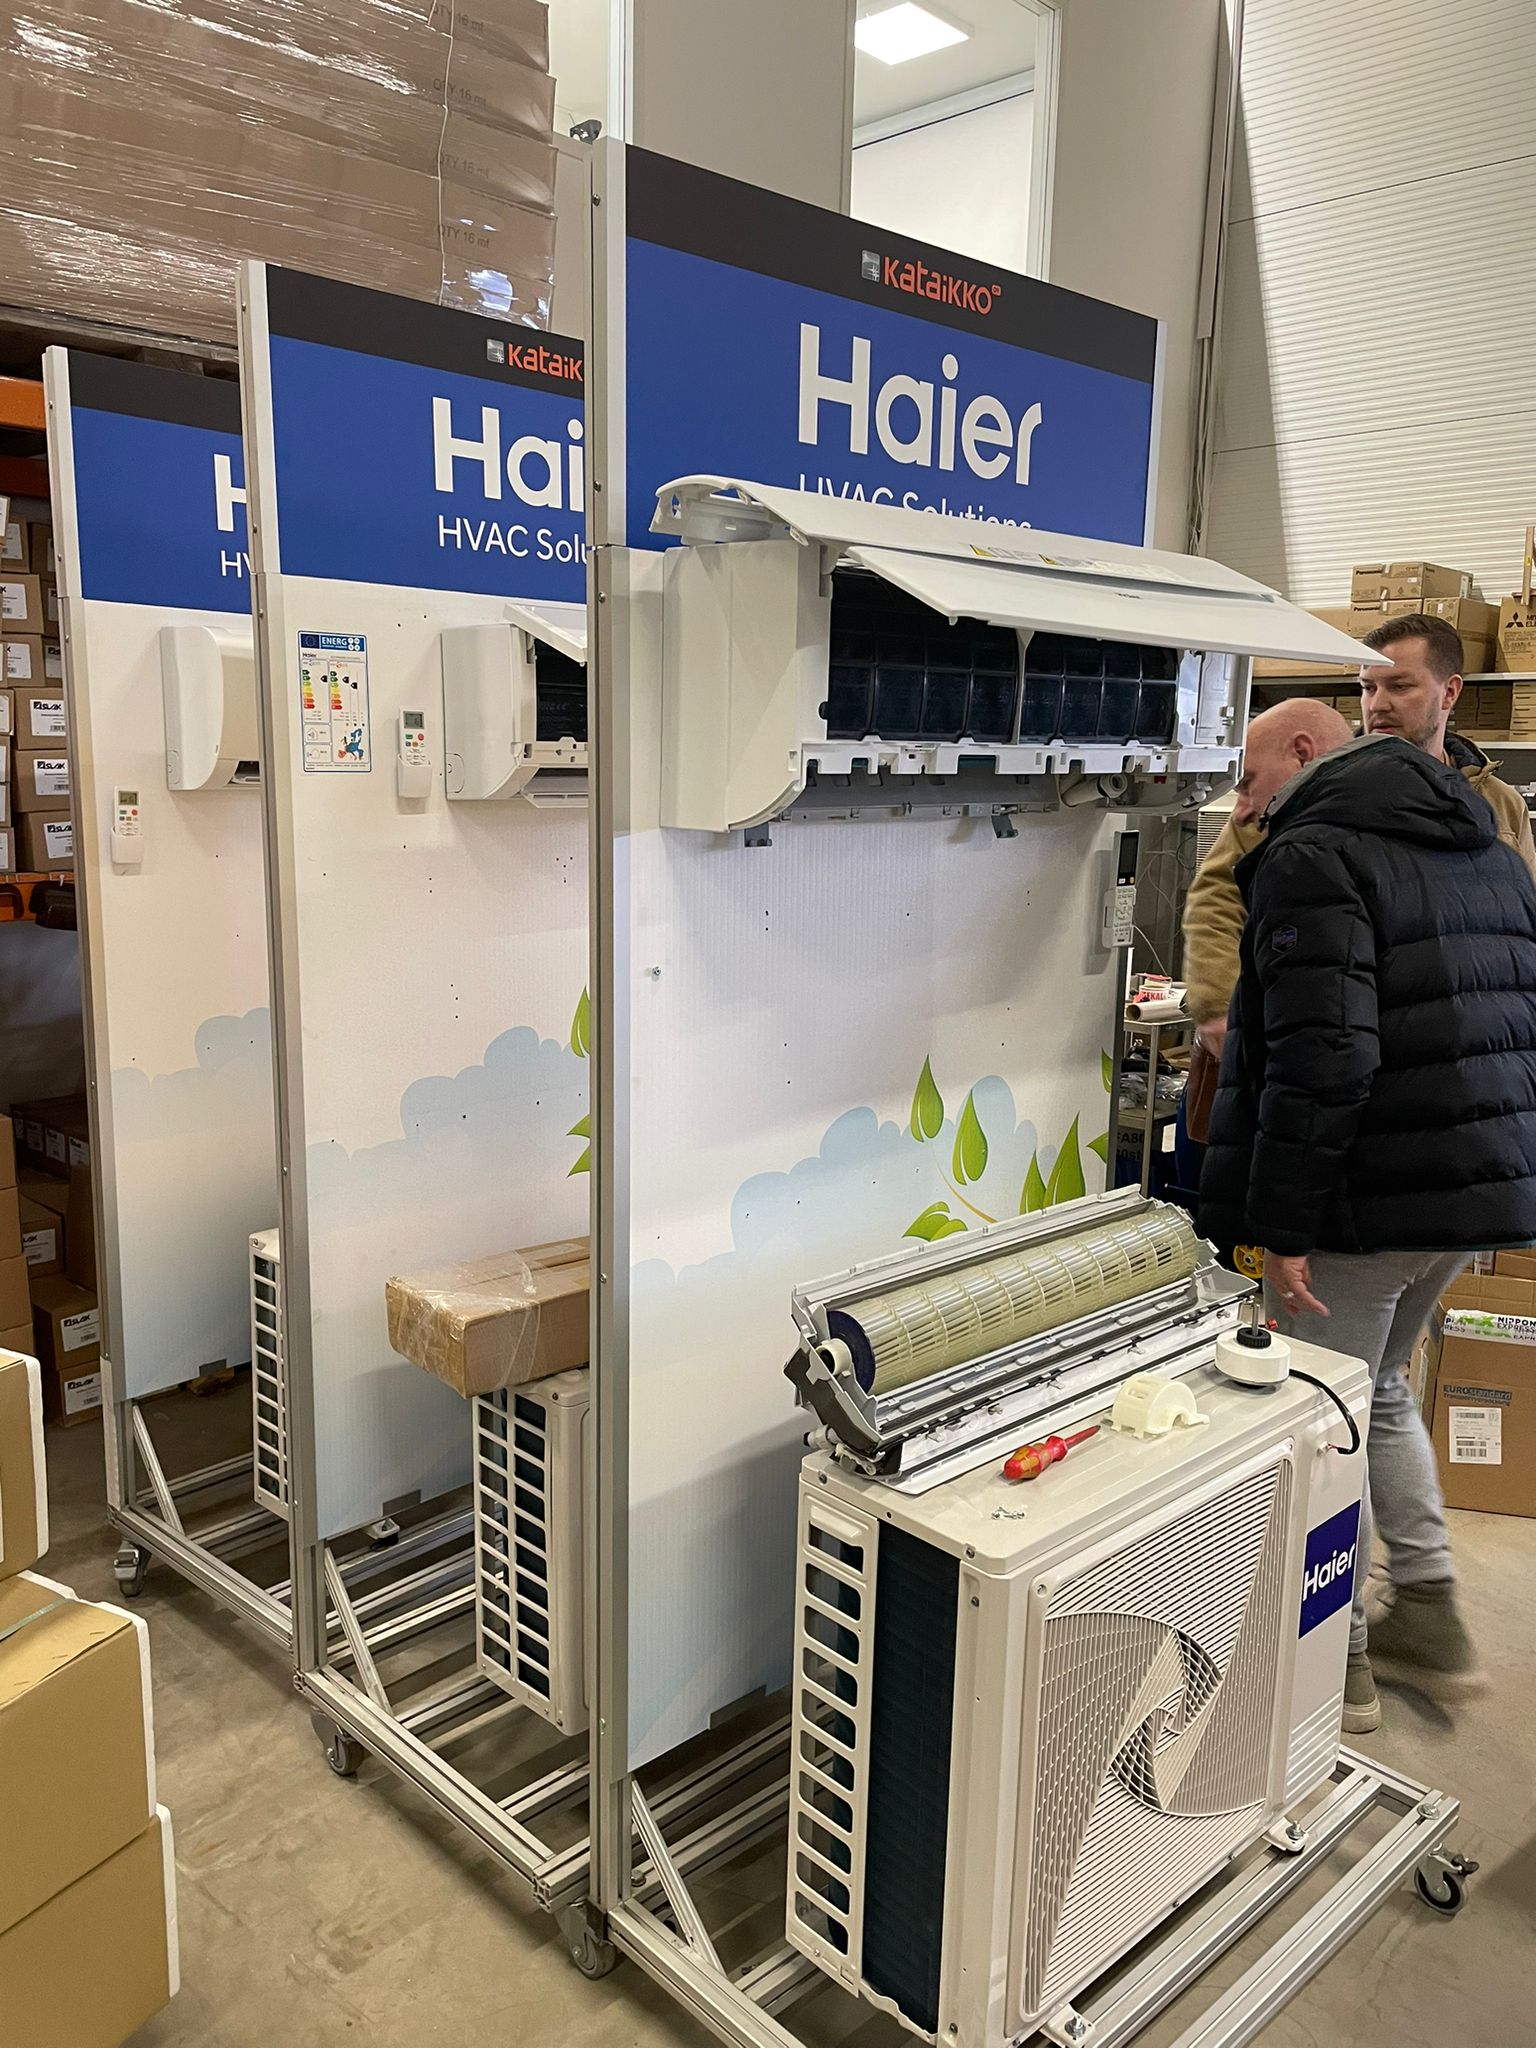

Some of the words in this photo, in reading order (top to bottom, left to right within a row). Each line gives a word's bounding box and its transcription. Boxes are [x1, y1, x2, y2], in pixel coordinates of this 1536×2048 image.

[799, 322, 1042, 486] Haier
[432, 396, 584, 513] Hai
[438, 514, 529, 558] HVAC
[321, 636, 348, 646] ENERG
[1303, 1543, 1356, 1602] Haier
